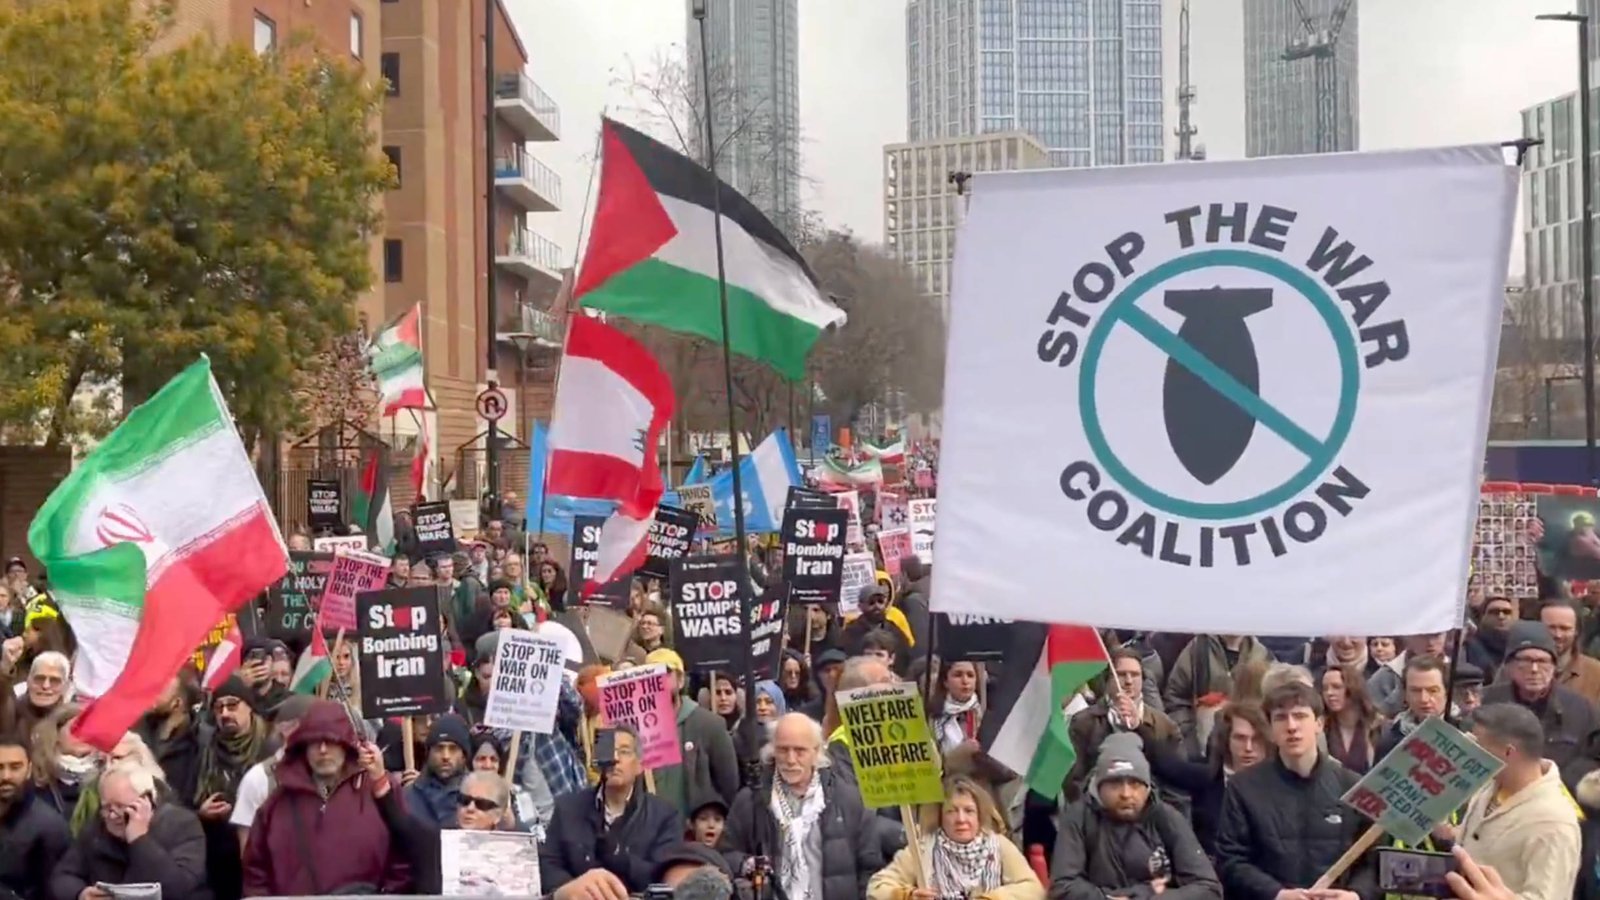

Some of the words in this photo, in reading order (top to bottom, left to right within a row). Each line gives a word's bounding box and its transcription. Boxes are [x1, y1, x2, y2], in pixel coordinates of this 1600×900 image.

[1037, 231, 1145, 367] STOP
[1164, 202, 1297, 252] THE
[1305, 225, 1410, 368] WAR
[417, 513, 446, 525] STOP
[1060, 460, 1370, 567] COALITION
[419, 531, 450, 541] WARS
[650, 521, 688, 538] STOP
[795, 519, 839, 541] Stop
[787, 542, 843, 558] Bombing
[335, 557, 364, 573] STOP
[365, 564, 384, 580] THE
[796, 557, 833, 575] Iran
[294, 576, 326, 589] HOLY
[329, 581, 356, 599] IRAN
[333, 571, 357, 585] WAR
[357, 575, 375, 590] ON
[682, 580, 738, 602] STOP
[281, 593, 305, 608] THE
[675, 599, 741, 618] TRUMP'S
[282, 612, 302, 629] OF
[369, 604, 427, 630] Stop
[680, 616, 742, 638] WARS
[363, 632, 438, 654] Bombing
[502, 642, 535, 661] STOP
[539, 648, 562, 665] THE
[376, 654, 426, 679] Iran
[500, 659, 527, 677] WAR
[530, 663, 549, 680] ON
[496, 676, 527, 694] IRAN
[603, 681, 636, 703] STOP
[639, 675, 665, 695] THE
[605, 700, 635, 720] WAR
[639, 694, 657, 713] ON
[844, 699, 918, 726] WELFARE
[850, 724, 883, 747] NOT
[855, 742, 931, 768] WARFARE
[1432, 730, 1468, 760] THEY
[1461, 759, 1490, 779] GOT
[1378, 785, 1414, 814] FEED
